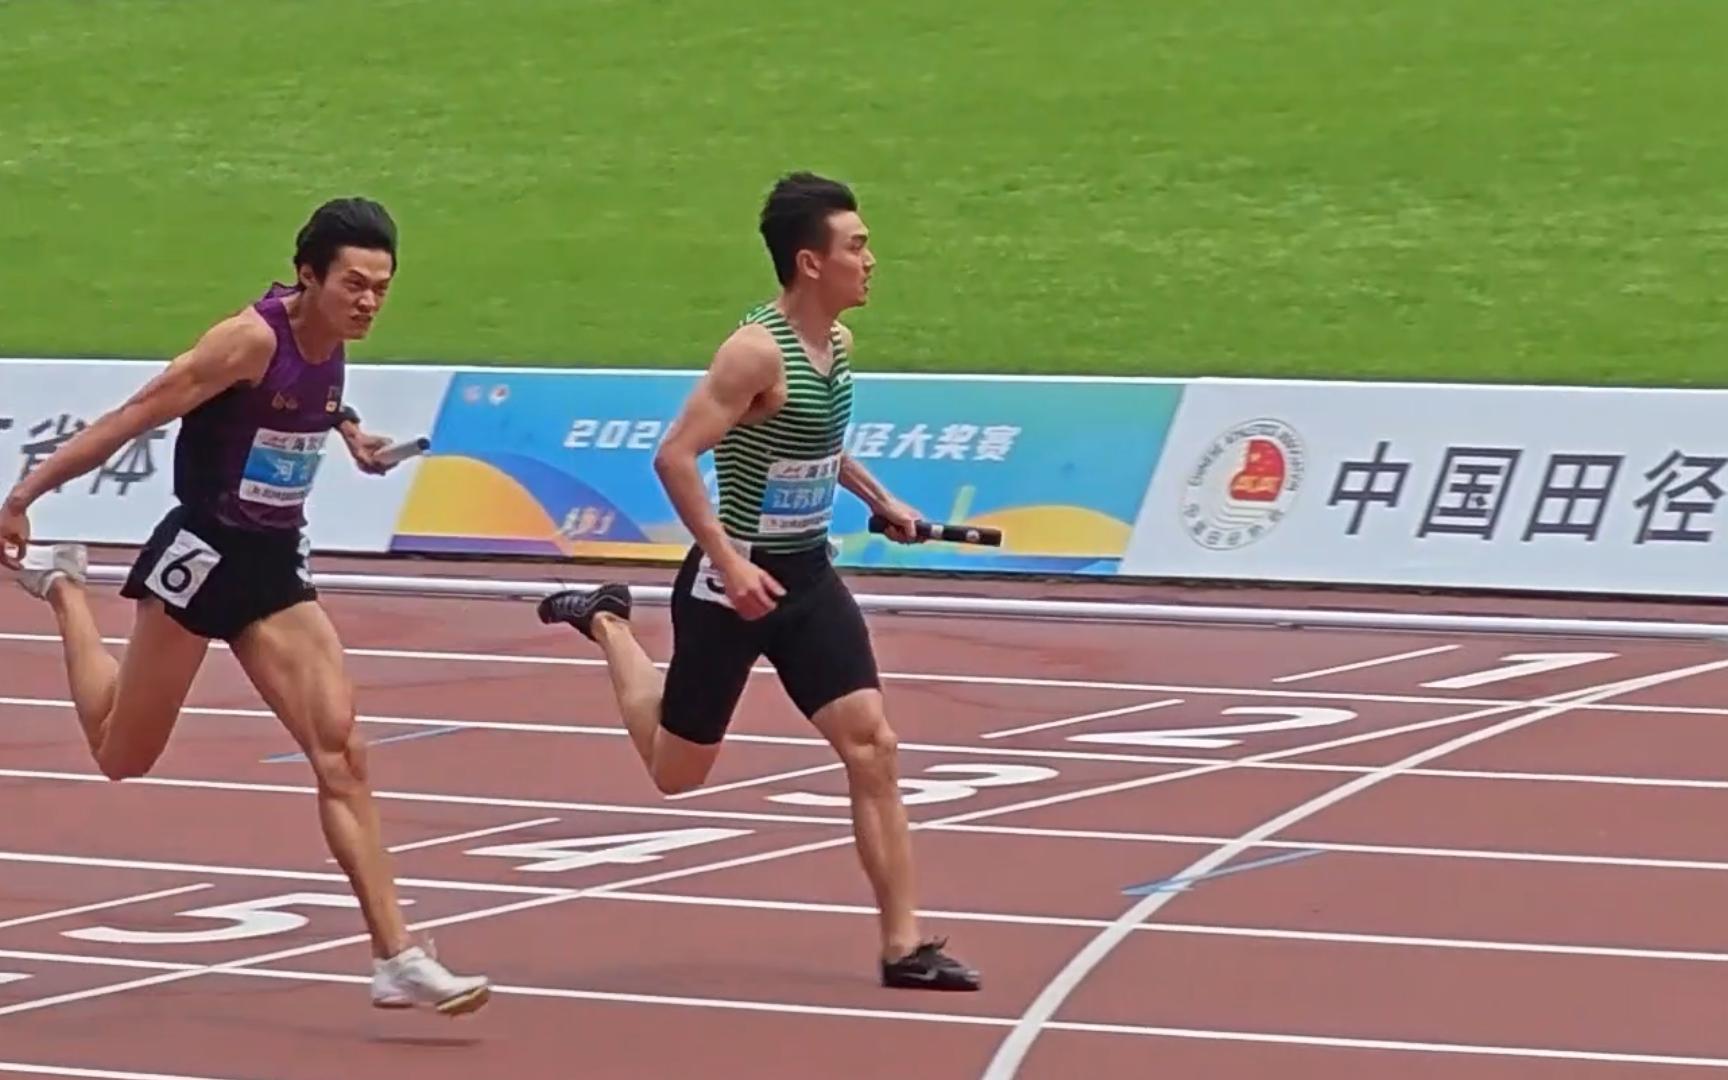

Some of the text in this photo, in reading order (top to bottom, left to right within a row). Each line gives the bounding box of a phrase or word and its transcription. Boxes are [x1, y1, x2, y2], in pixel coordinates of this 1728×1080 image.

[563, 419, 661, 449] 202
[844, 422, 1022, 461] 径大奖赛
[1327, 441, 1728, 545] 中国田径
[161, 548, 205, 593] 6
[1419, 652, 1621, 689] 1
[1065, 706, 1358, 749] 2
[764, 764, 1060, 805] 3
[463, 827, 755, 871] 4
[58, 891, 415, 944] 5
